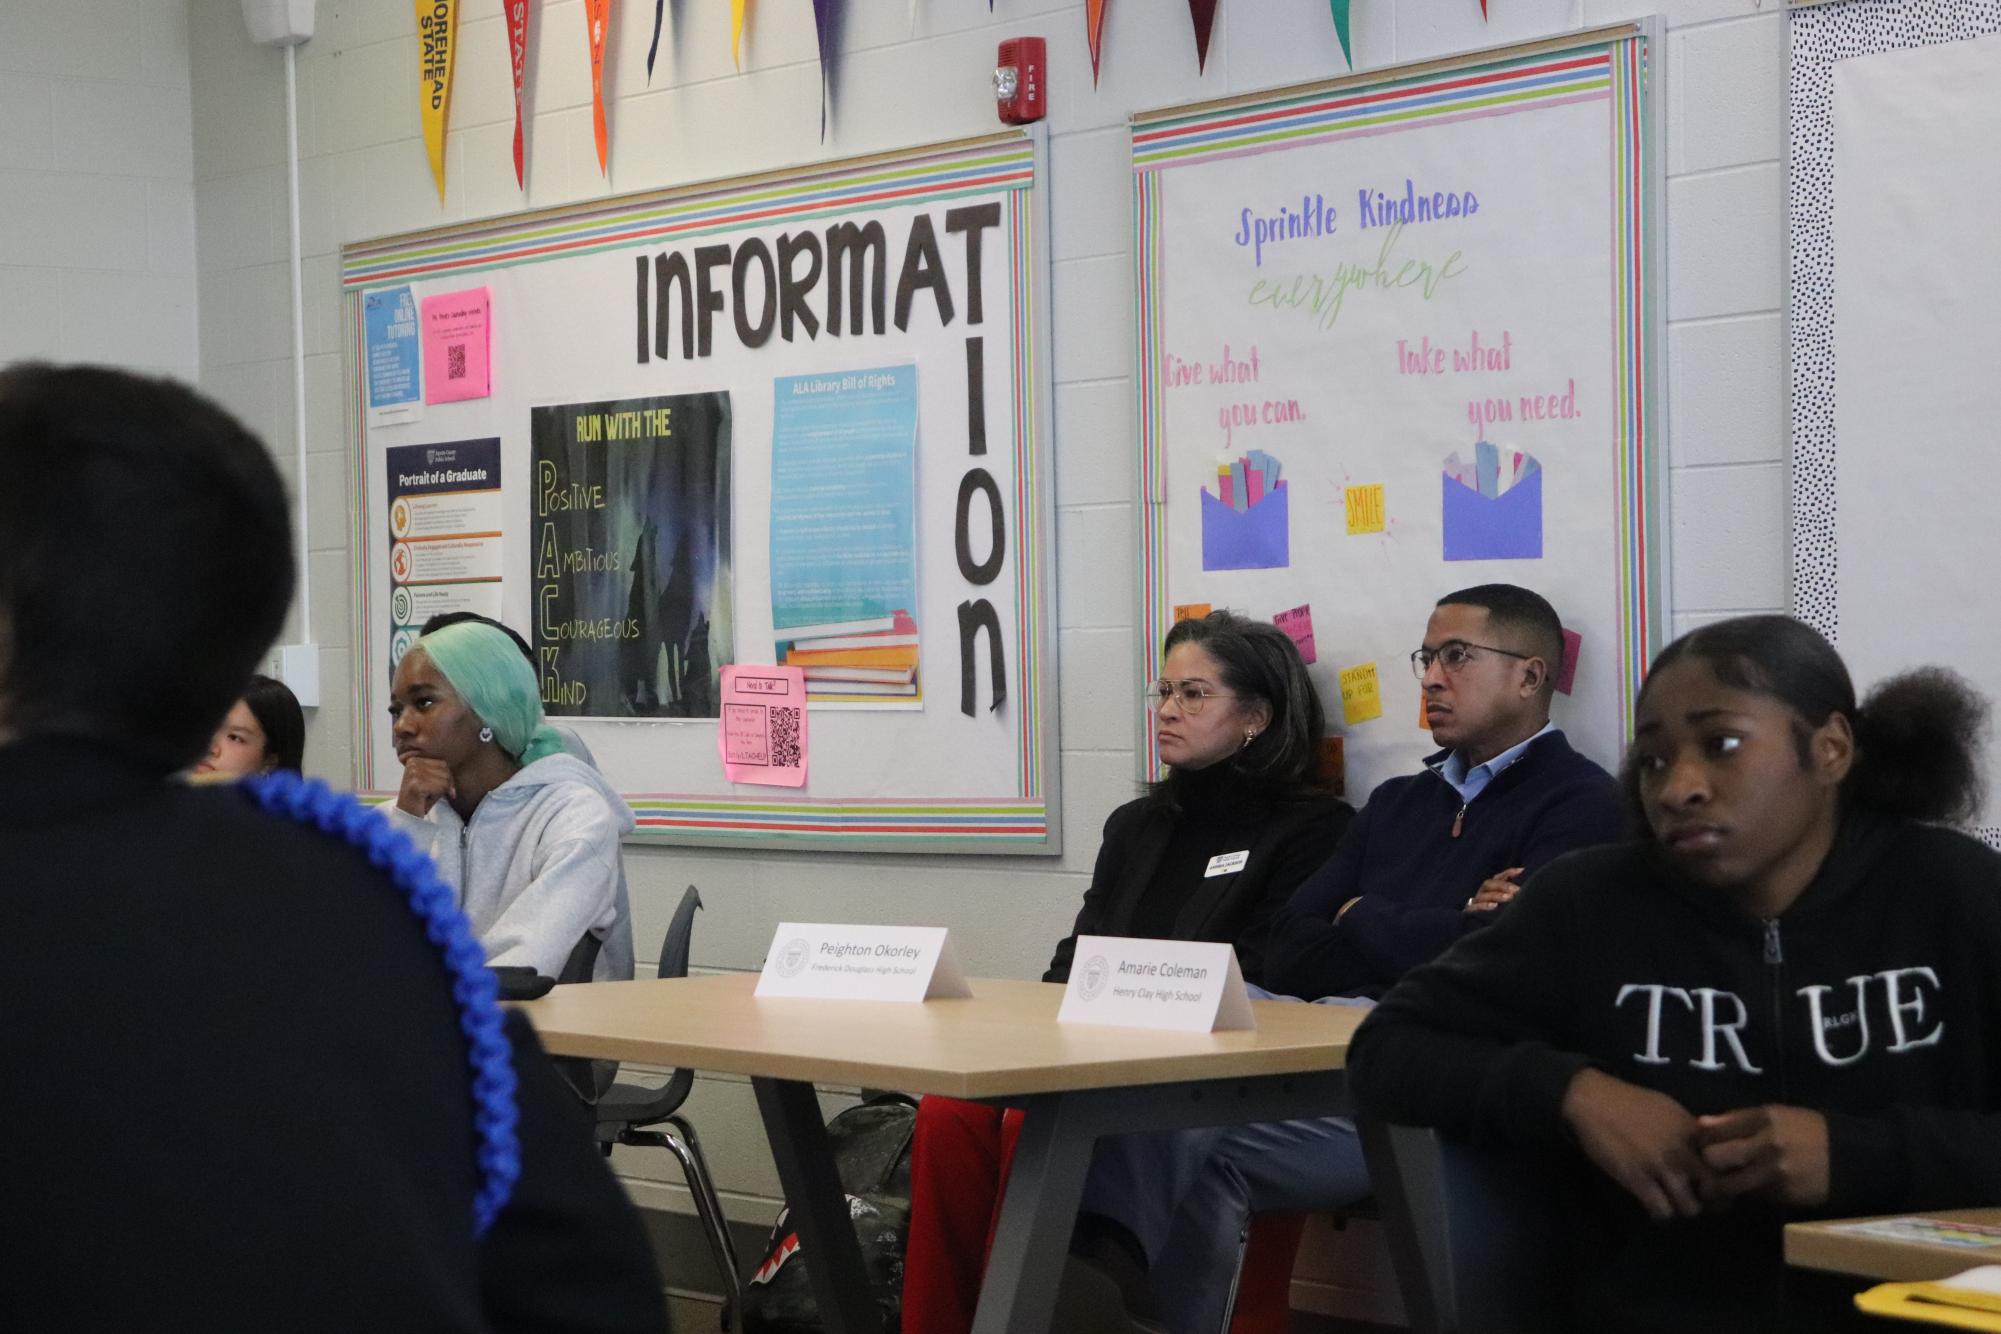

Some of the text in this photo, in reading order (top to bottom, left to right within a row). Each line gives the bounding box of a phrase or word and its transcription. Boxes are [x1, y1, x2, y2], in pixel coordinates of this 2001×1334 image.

[421, 15, 434, 81] STATE
[432, 0, 449, 110] OREHEAD
[1027, 64, 1035, 101] FIRE
[1235, 178, 1479, 267] Sprinkle Kindness
[1248, 218, 1469, 330] everywhere
[1209, 343, 1260, 384] what
[1396, 329, 1512, 374] Take what
[793, 373, 896, 395] ALA Library Bill of Rights
[576, 407, 672, 442] RUN WITH THE
[1219, 402, 1257, 449] you
[1467, 377, 1581, 441] you need.
[398, 468, 487, 487] Portrait of a Graduate
[1346, 486, 1383, 529] SMILE
[820, 942, 872, 958] Peighton
[875, 944, 920, 960] Okorley
[876, 965, 892, 975] High
[893, 966, 917, 975] School
[1118, 960, 1208, 980] Amarie Coleman
[1112, 986, 1203, 1003] Henry Clay High School
[1615, 966, 1945, 1076] TRUE
